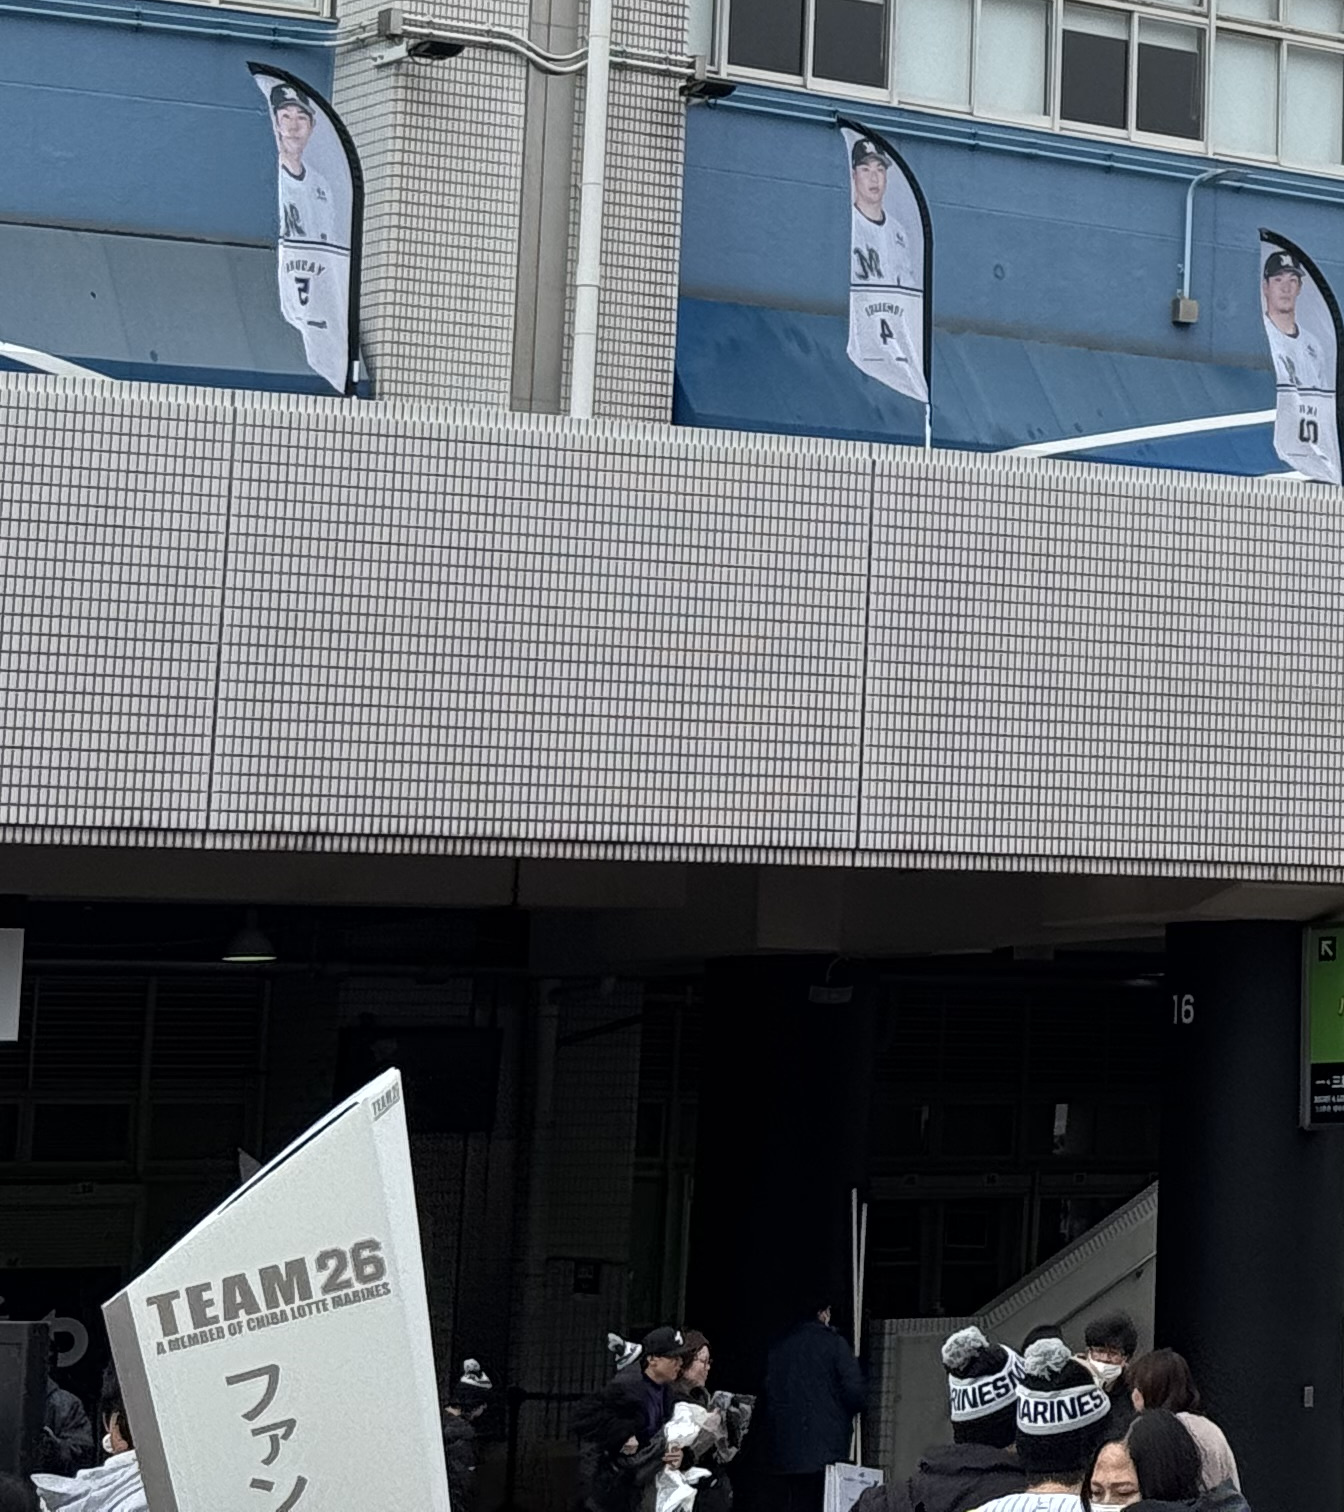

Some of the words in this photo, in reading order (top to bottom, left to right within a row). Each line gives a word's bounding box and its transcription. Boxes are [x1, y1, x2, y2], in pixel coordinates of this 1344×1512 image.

[1173, 994, 1194, 1024] 16
[157, 1342, 167, 1355] A
[168, 1325, 225, 1352] MEMBER
[228, 1321, 244, 1336] OF
[247, 1311, 289, 1332] CHIBA
[291, 1297, 329, 1321] LOTTE
[332, 1282, 391, 1310] MARINES
[951, 1375, 1011, 1412] RINES
[1018, 1389, 1106, 1424] ARINES
